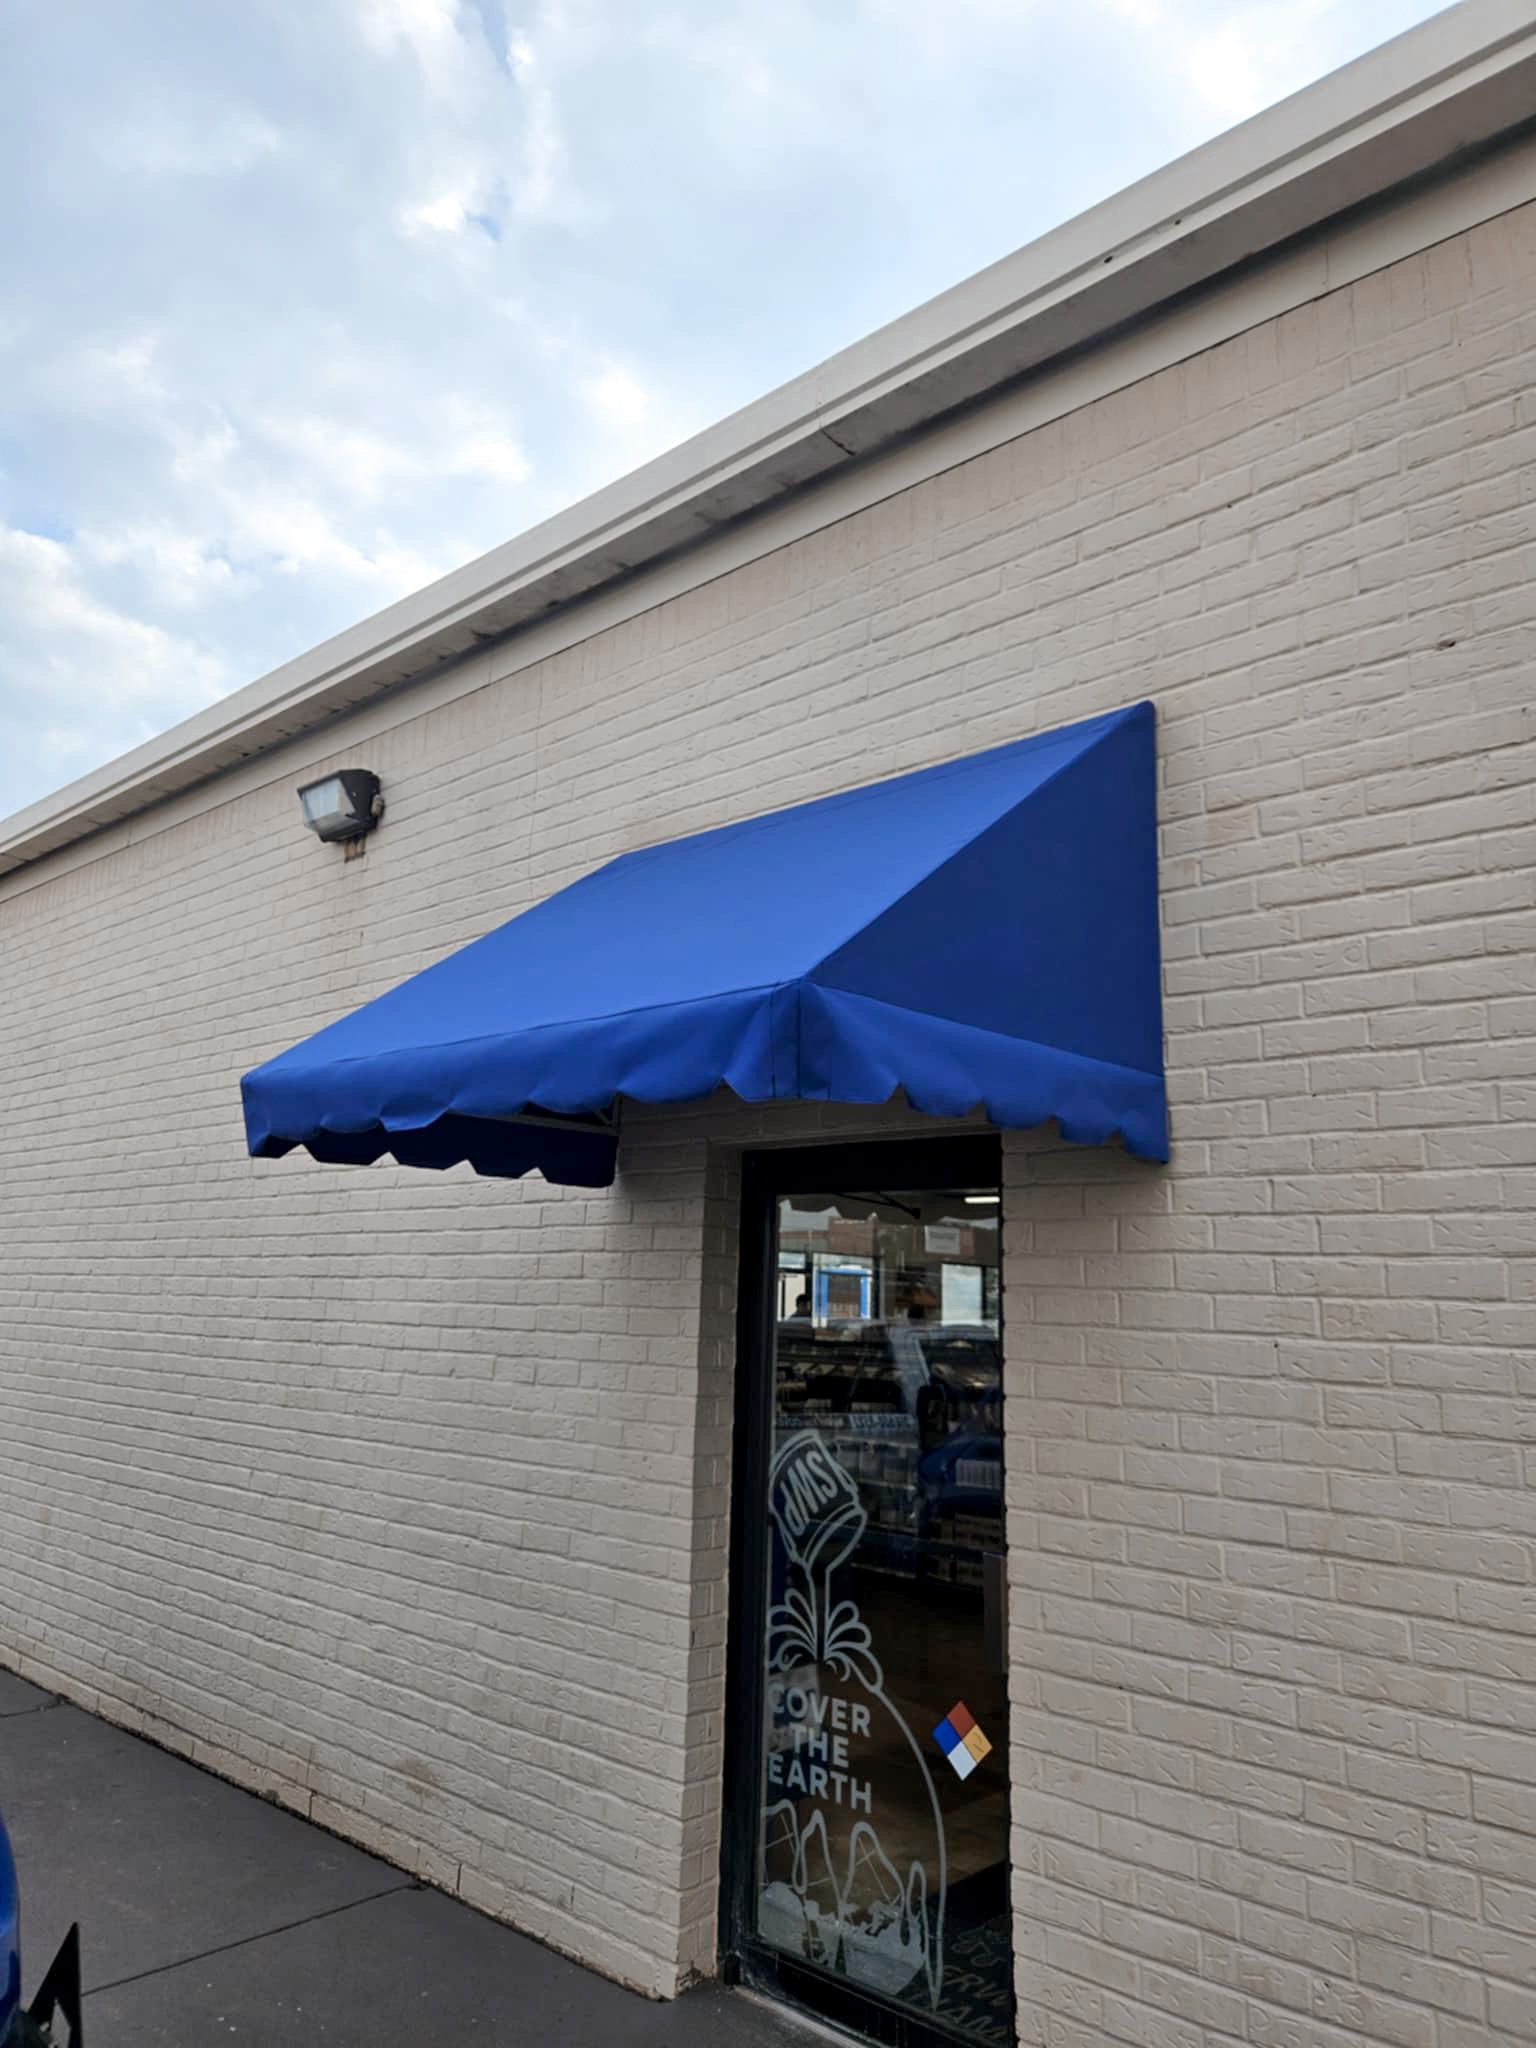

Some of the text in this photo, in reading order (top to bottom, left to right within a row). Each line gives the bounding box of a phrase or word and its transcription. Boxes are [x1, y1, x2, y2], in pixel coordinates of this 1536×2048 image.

[780, 1451, 837, 1536] SWP
[768, 1682, 871, 1738] COVER
[789, 1722, 849, 1768] THE
[768, 1752, 872, 1814] EARTH
